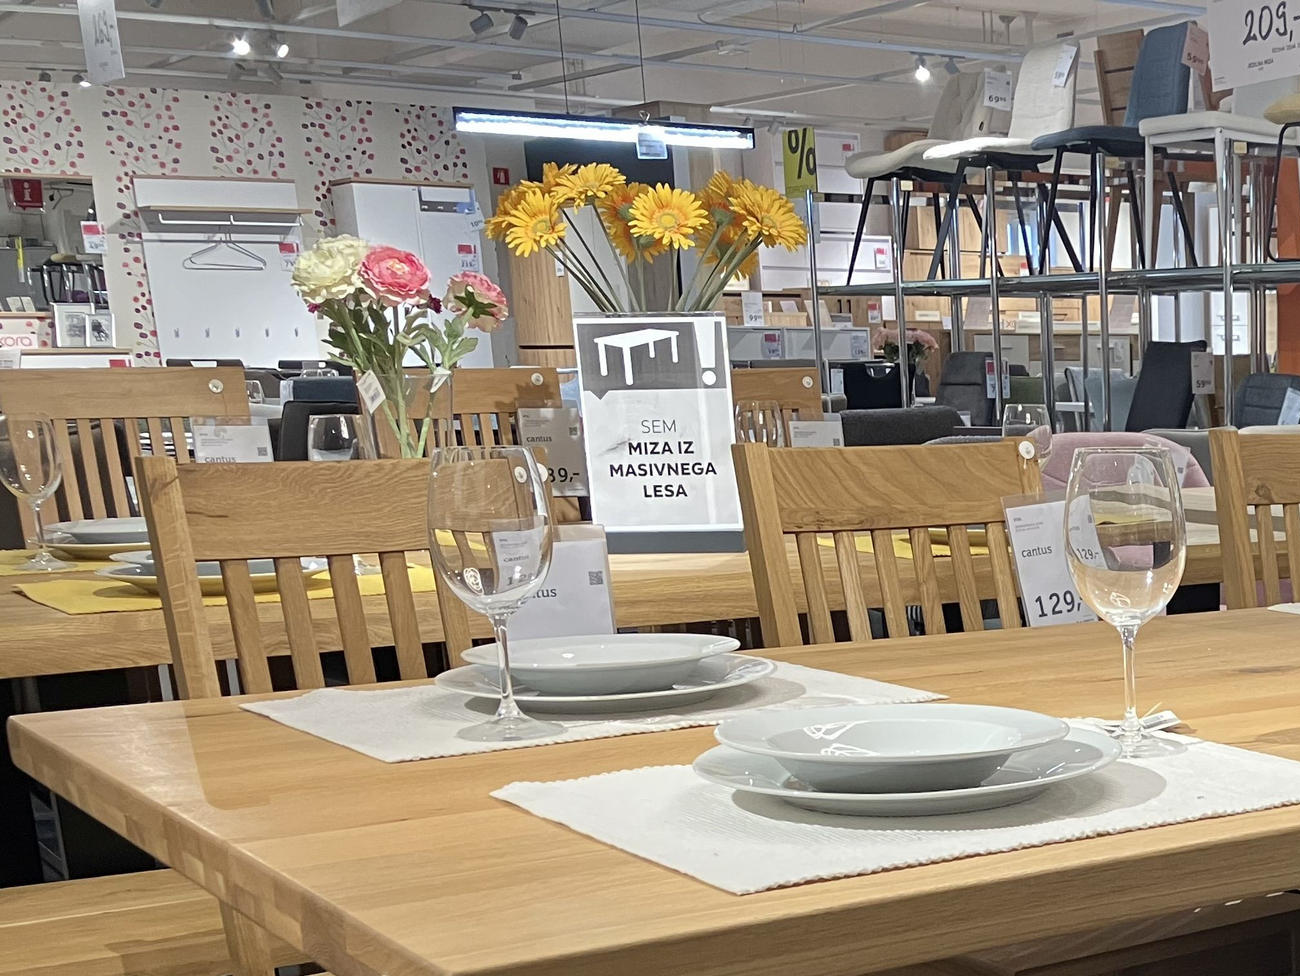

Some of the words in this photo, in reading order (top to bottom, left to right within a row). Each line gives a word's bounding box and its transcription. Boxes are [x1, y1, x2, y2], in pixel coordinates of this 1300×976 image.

[641, 419, 677, 434] SEM
[628, 441, 673, 456] MIZA
[677, 440, 695, 455] IZ
[609, 462, 718, 478] MASIVNEGA
[643, 484, 688, 498] LESA
[1021, 545, 1053, 558] cantus
[1035, 589, 1083, 618] 129,
